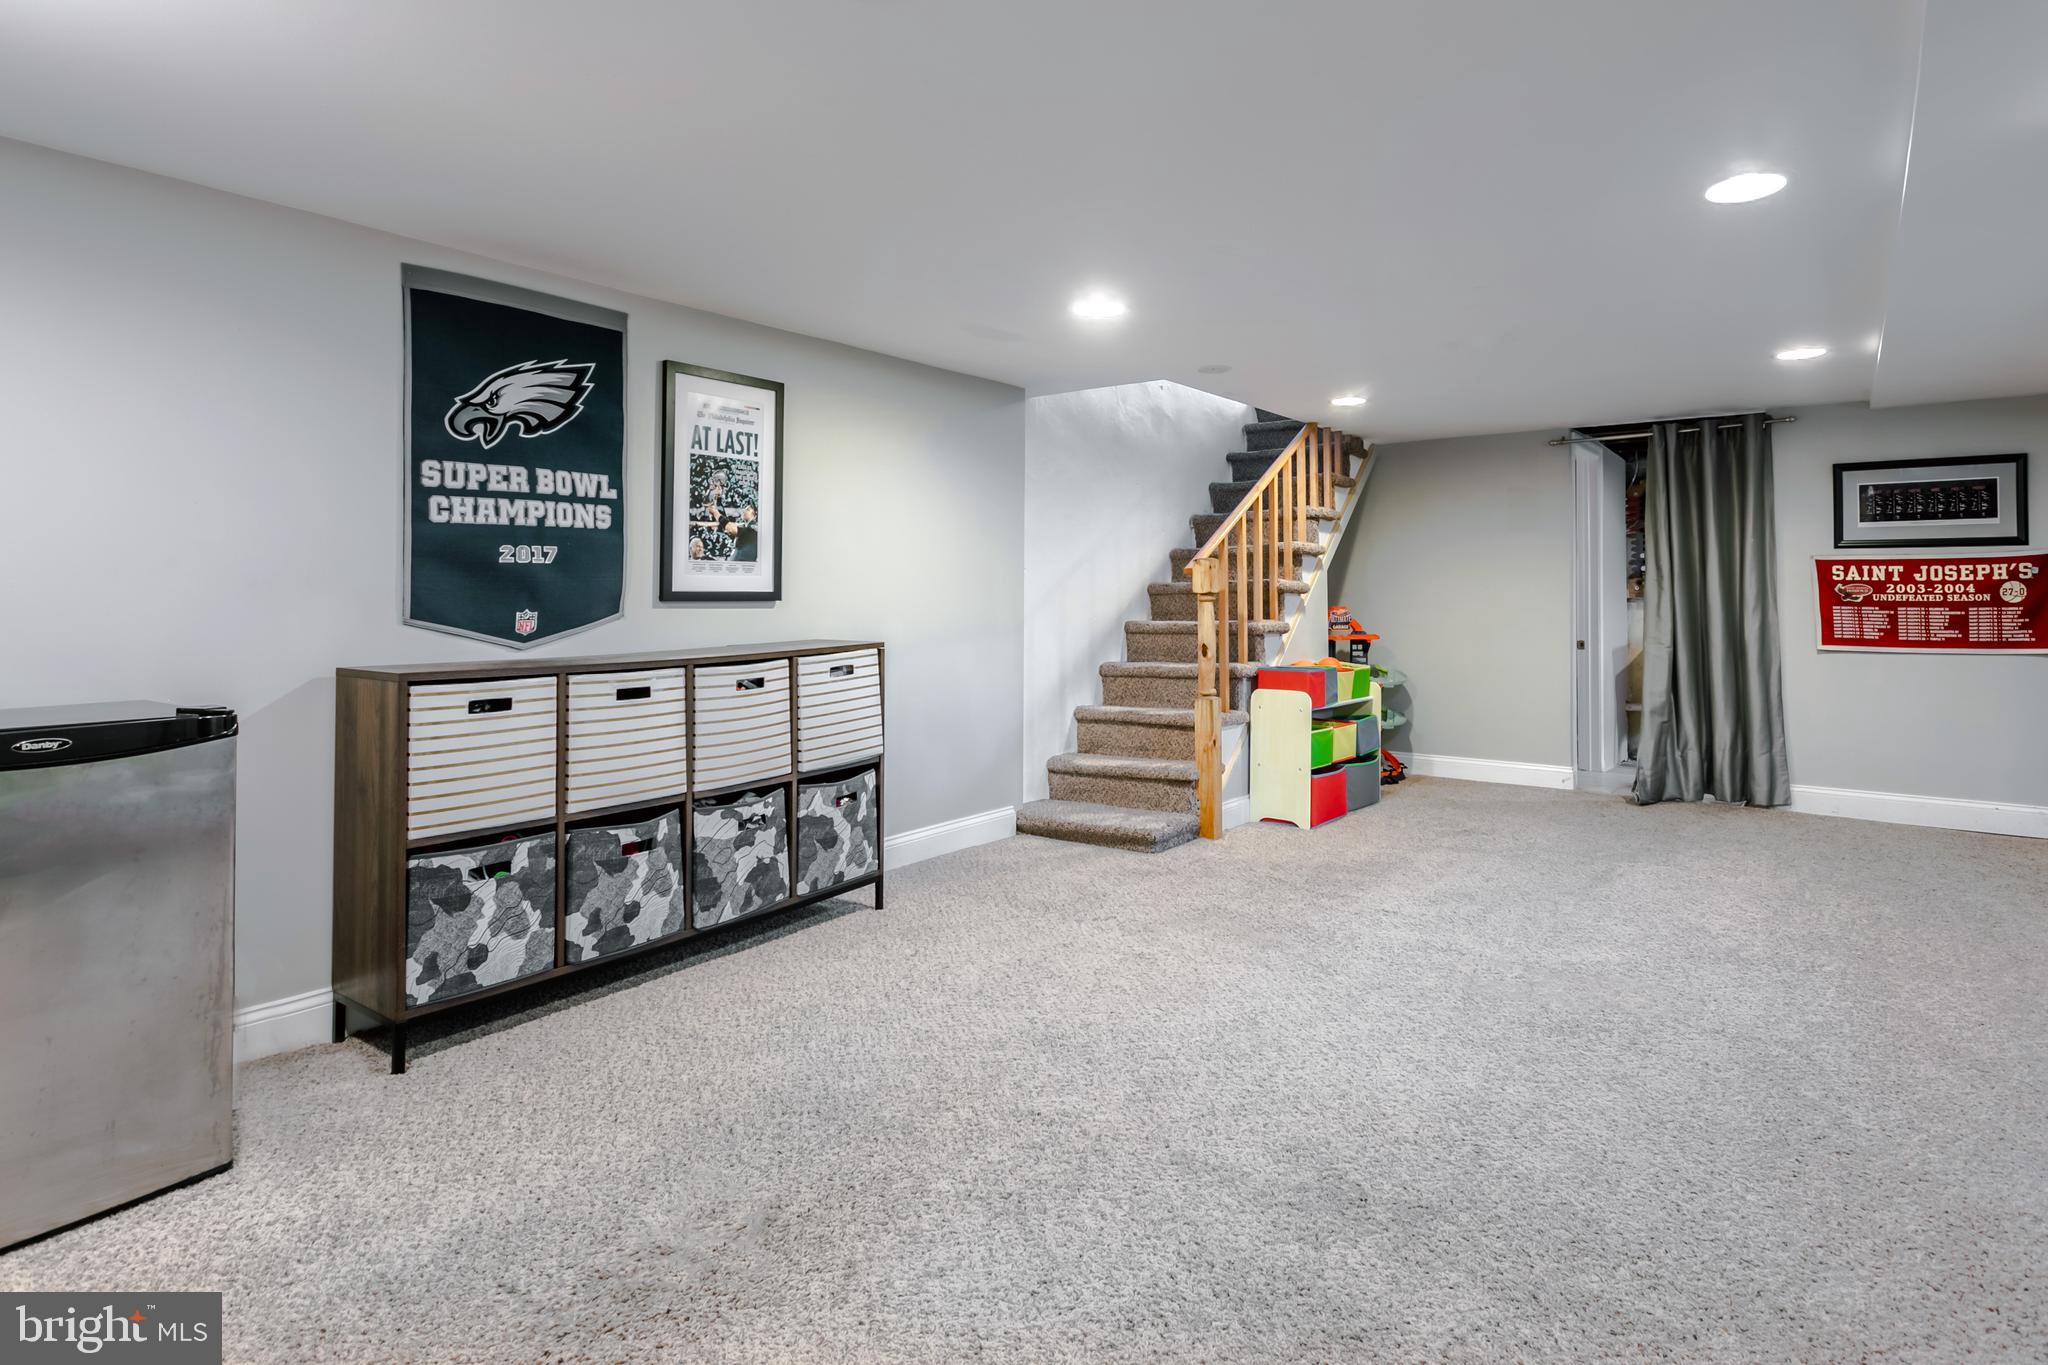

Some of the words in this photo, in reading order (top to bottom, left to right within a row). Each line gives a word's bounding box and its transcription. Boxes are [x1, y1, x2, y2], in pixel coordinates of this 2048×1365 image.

[691, 424, 711, 451] AT
[716, 427, 759, 457] LAST!
[420, 459, 530, 493] SUPER
[535, 467, 618, 500] BOWL
[427, 495, 612, 530] CHAMPIONS
[498, 544, 558, 564] 2017
[1831, 565, 1904, 582] SAINT
[1913, 562, 2034, 582] JOSEPH'S
[1886, 583, 1976, 594] 2003-2004
[2002, 587, 2025, 596] 27-0
[1872, 593, 1943, 602] UNDEFEATED
[1946, 593, 1991, 602] SEASON
[516, 619, 535, 632] NFL
[21, 742, 60, 751] Danby
